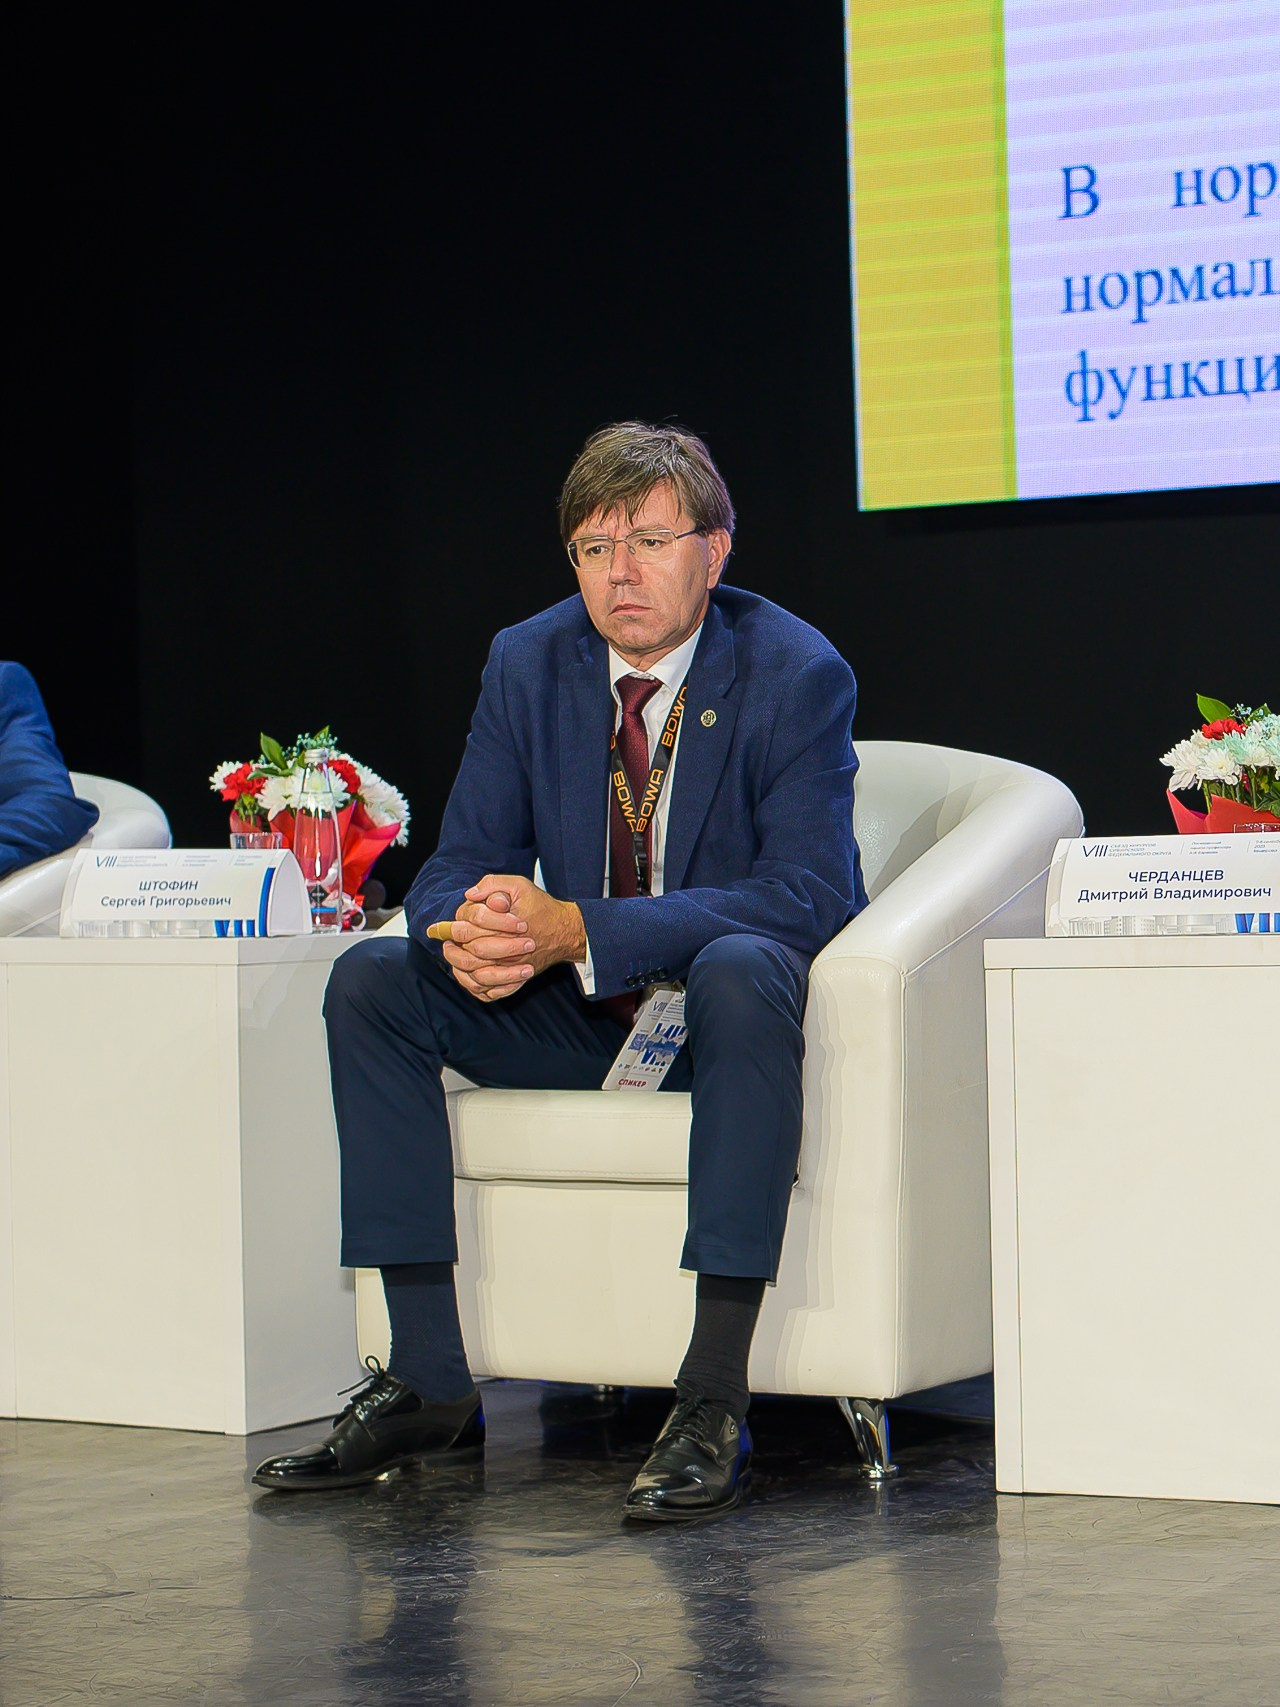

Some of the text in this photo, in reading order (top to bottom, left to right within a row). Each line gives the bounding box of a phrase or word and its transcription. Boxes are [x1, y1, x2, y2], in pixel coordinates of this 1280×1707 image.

[1058, 163, 1101, 219] В
[636, 768, 664, 833] BOWA
[1082, 844, 1109, 858] VIII
[95, 855, 118, 868] VIII
[1128, 869, 1225, 884] ЧЕРДАНЦЕВ
[138, 880, 199, 892] ШТОФИН
[100, 895, 232, 909] Сергей Григорьевич
[1077, 886, 1272, 904] Дмитрий Владимирович
[618, 1078, 647, 1088] СПИКЕР
